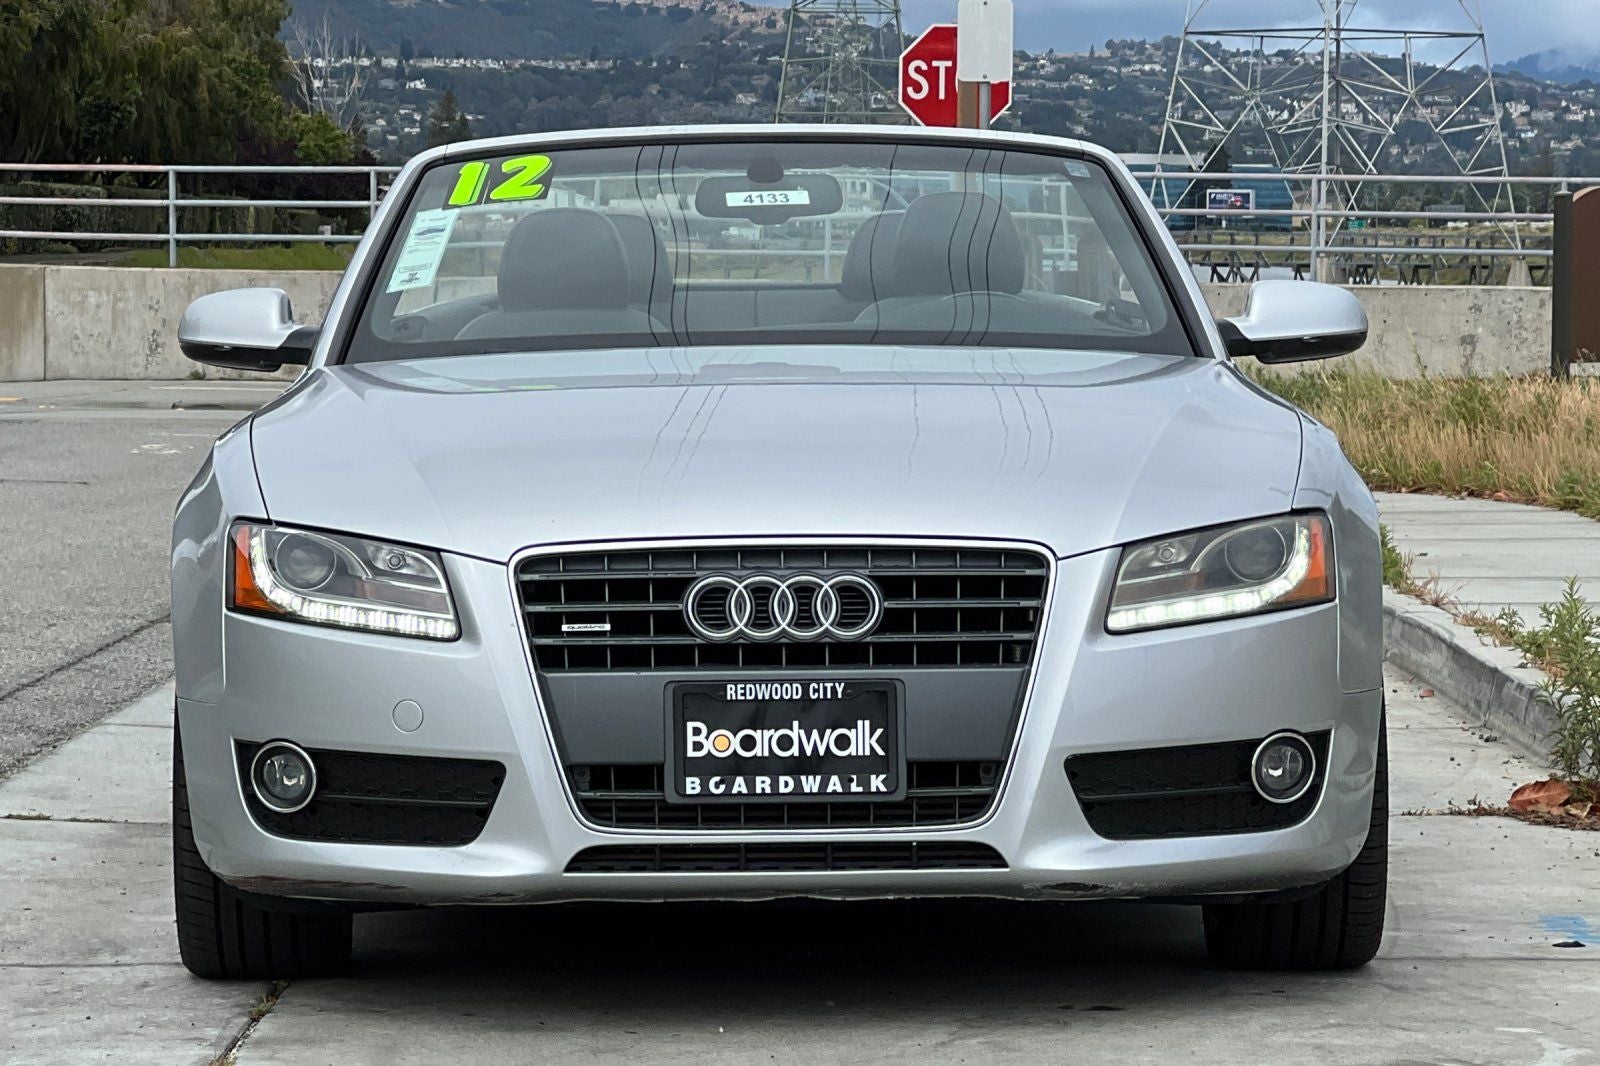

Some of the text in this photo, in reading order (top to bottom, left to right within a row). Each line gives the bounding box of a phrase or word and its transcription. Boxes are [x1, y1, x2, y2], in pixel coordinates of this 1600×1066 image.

[906, 59, 958, 100] ST
[448, 154, 553, 206] 12
[743, 193, 790, 204] 4133
[726, 682, 845, 700] REDWOOD CITY
[686, 719, 886, 758] Boardwalk
[685, 774, 888, 795] BOARDWALK
